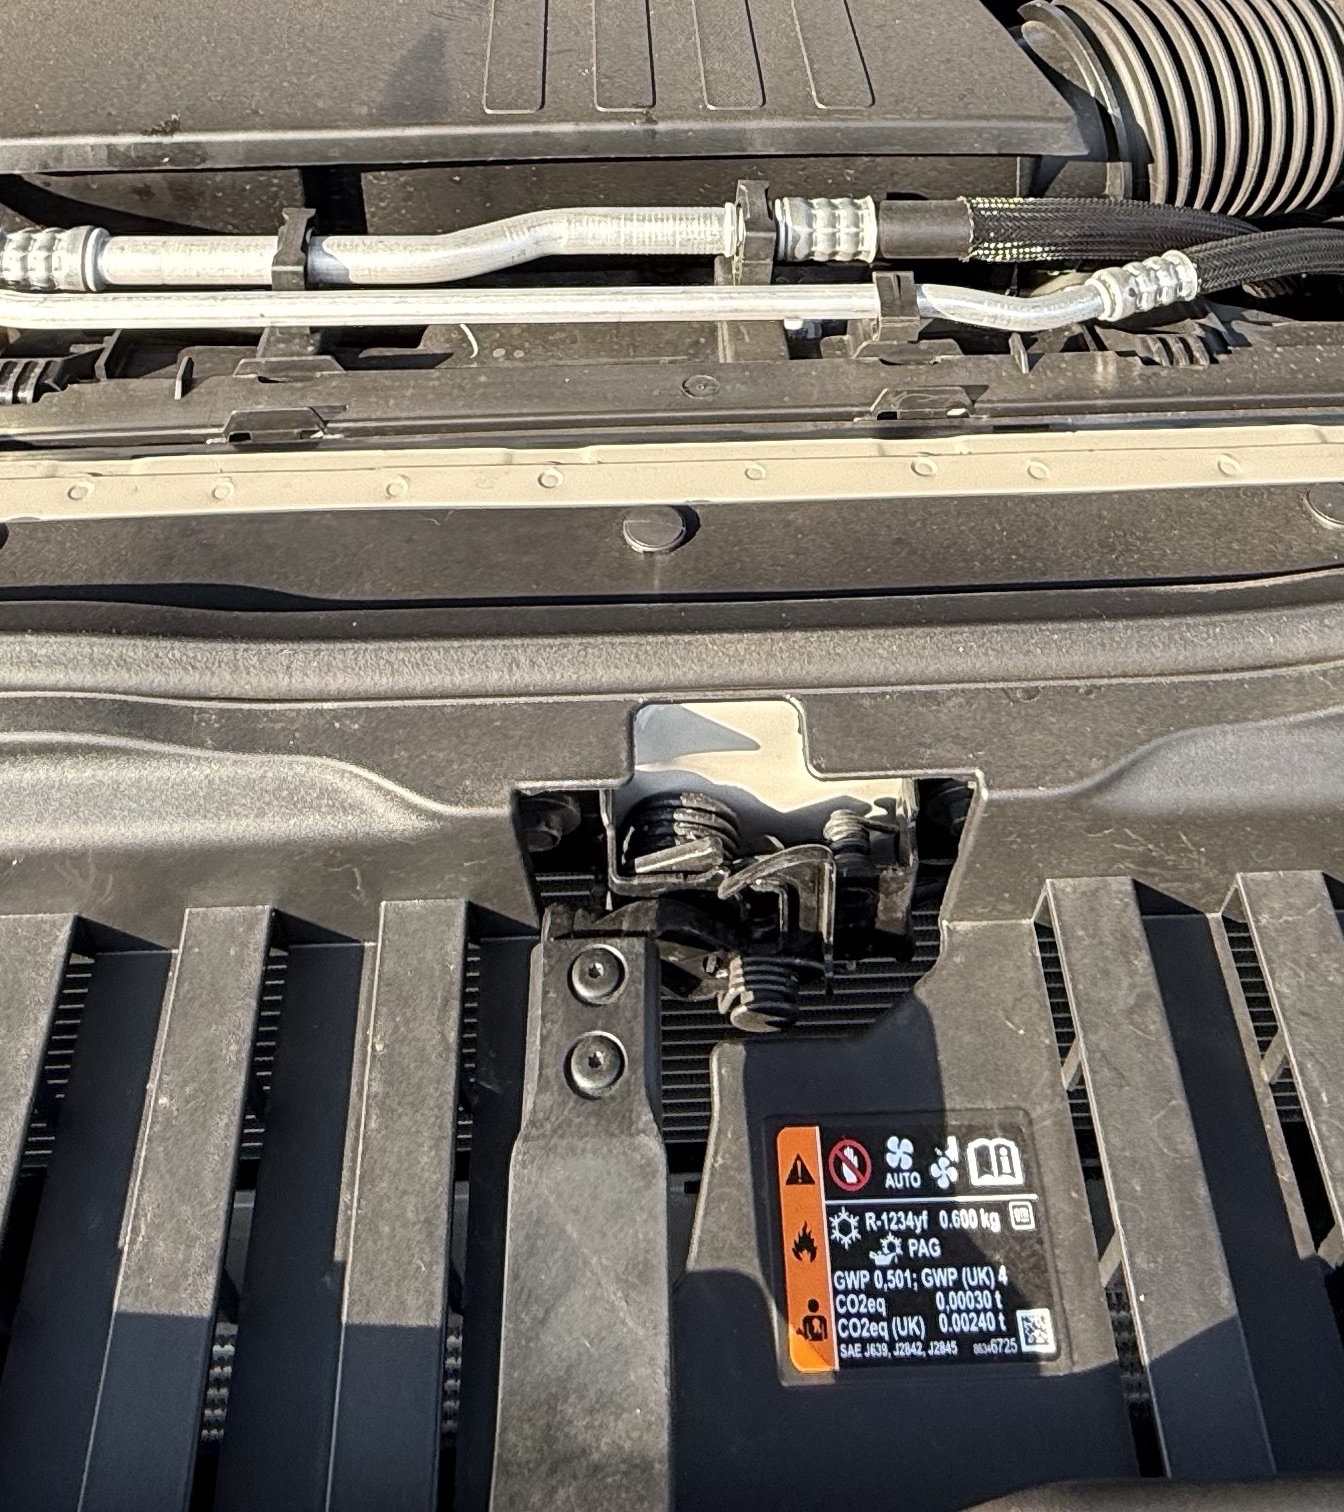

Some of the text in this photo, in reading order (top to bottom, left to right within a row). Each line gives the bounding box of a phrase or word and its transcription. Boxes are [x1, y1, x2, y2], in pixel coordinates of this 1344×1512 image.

[885, 1172, 921, 1189] AUTO
[865, 1209, 1001, 1234] R-1234yf 0.600 kg
[908, 1238, 941, 1258] PAG
[834, 1270, 871, 1290] GWP
[874, 1268, 918, 1291] 0,501;
[921, 1267, 958, 1288] GWP
[962, 1266, 995, 1289] (UK)
[835, 1291, 1003, 1317] CO2eq 0,00030 t
[838, 1313, 1006, 1340] CO2eq (UK) 0.00240 t
[840, 1344, 862, 1358] SAE
